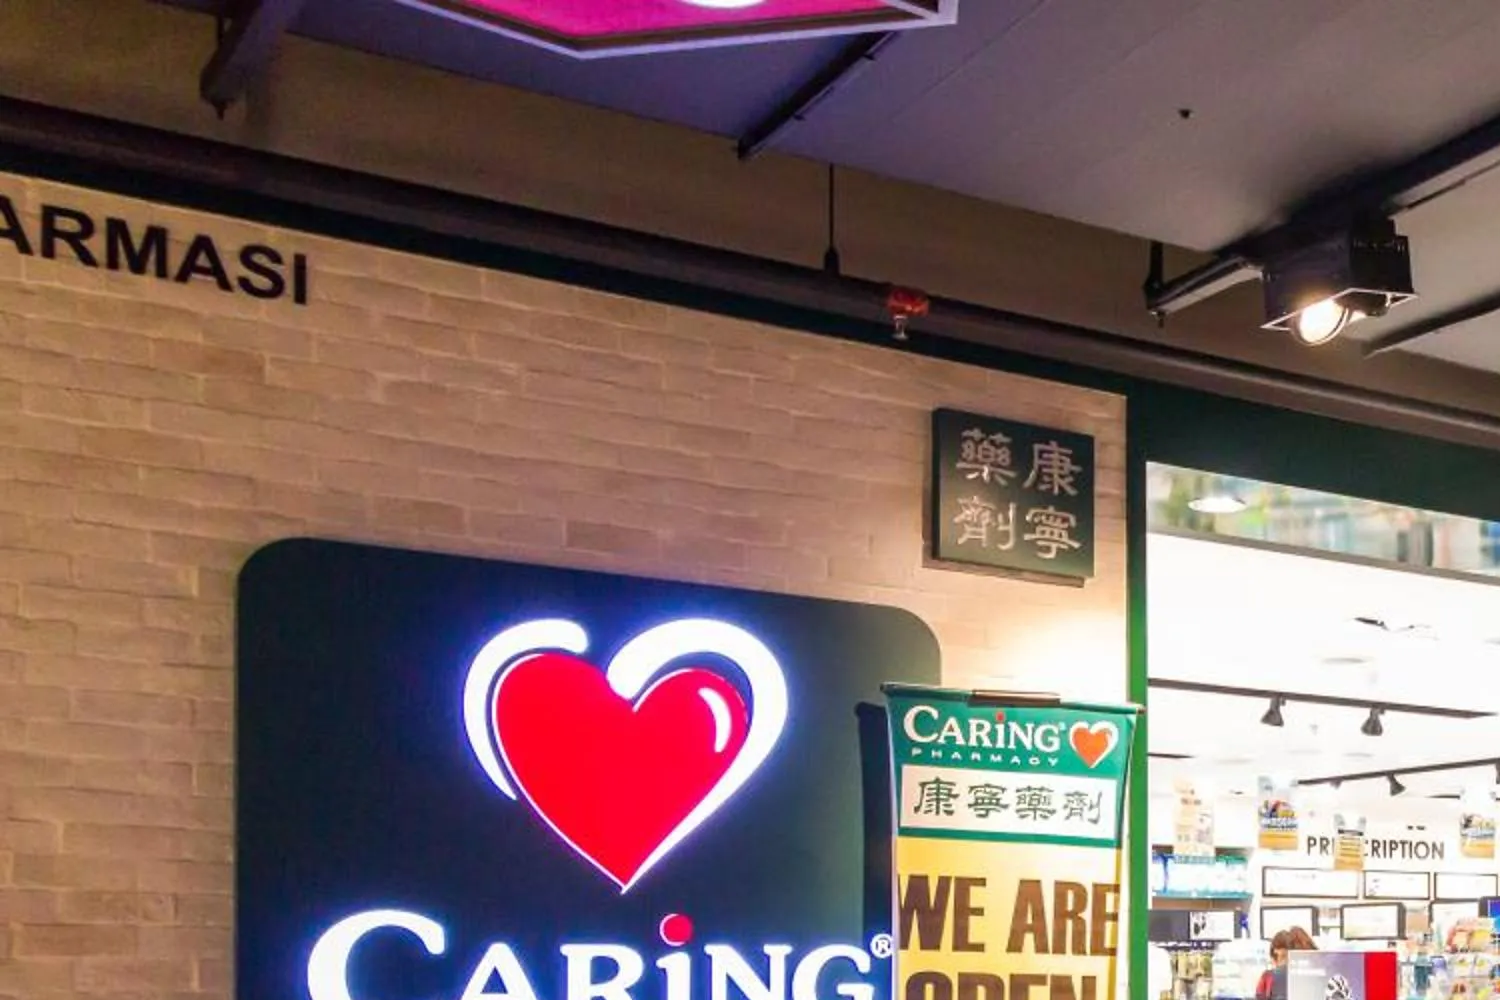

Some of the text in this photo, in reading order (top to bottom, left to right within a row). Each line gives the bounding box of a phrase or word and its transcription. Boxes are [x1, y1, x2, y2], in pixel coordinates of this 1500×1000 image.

[911, 747, 1059, 767] PHARMACY
[913, 776, 1102, 825] 康寧藥劑
[1307, 835, 1445, 860] PRRIPTION
[898, 873, 1120, 956] WE ARE
